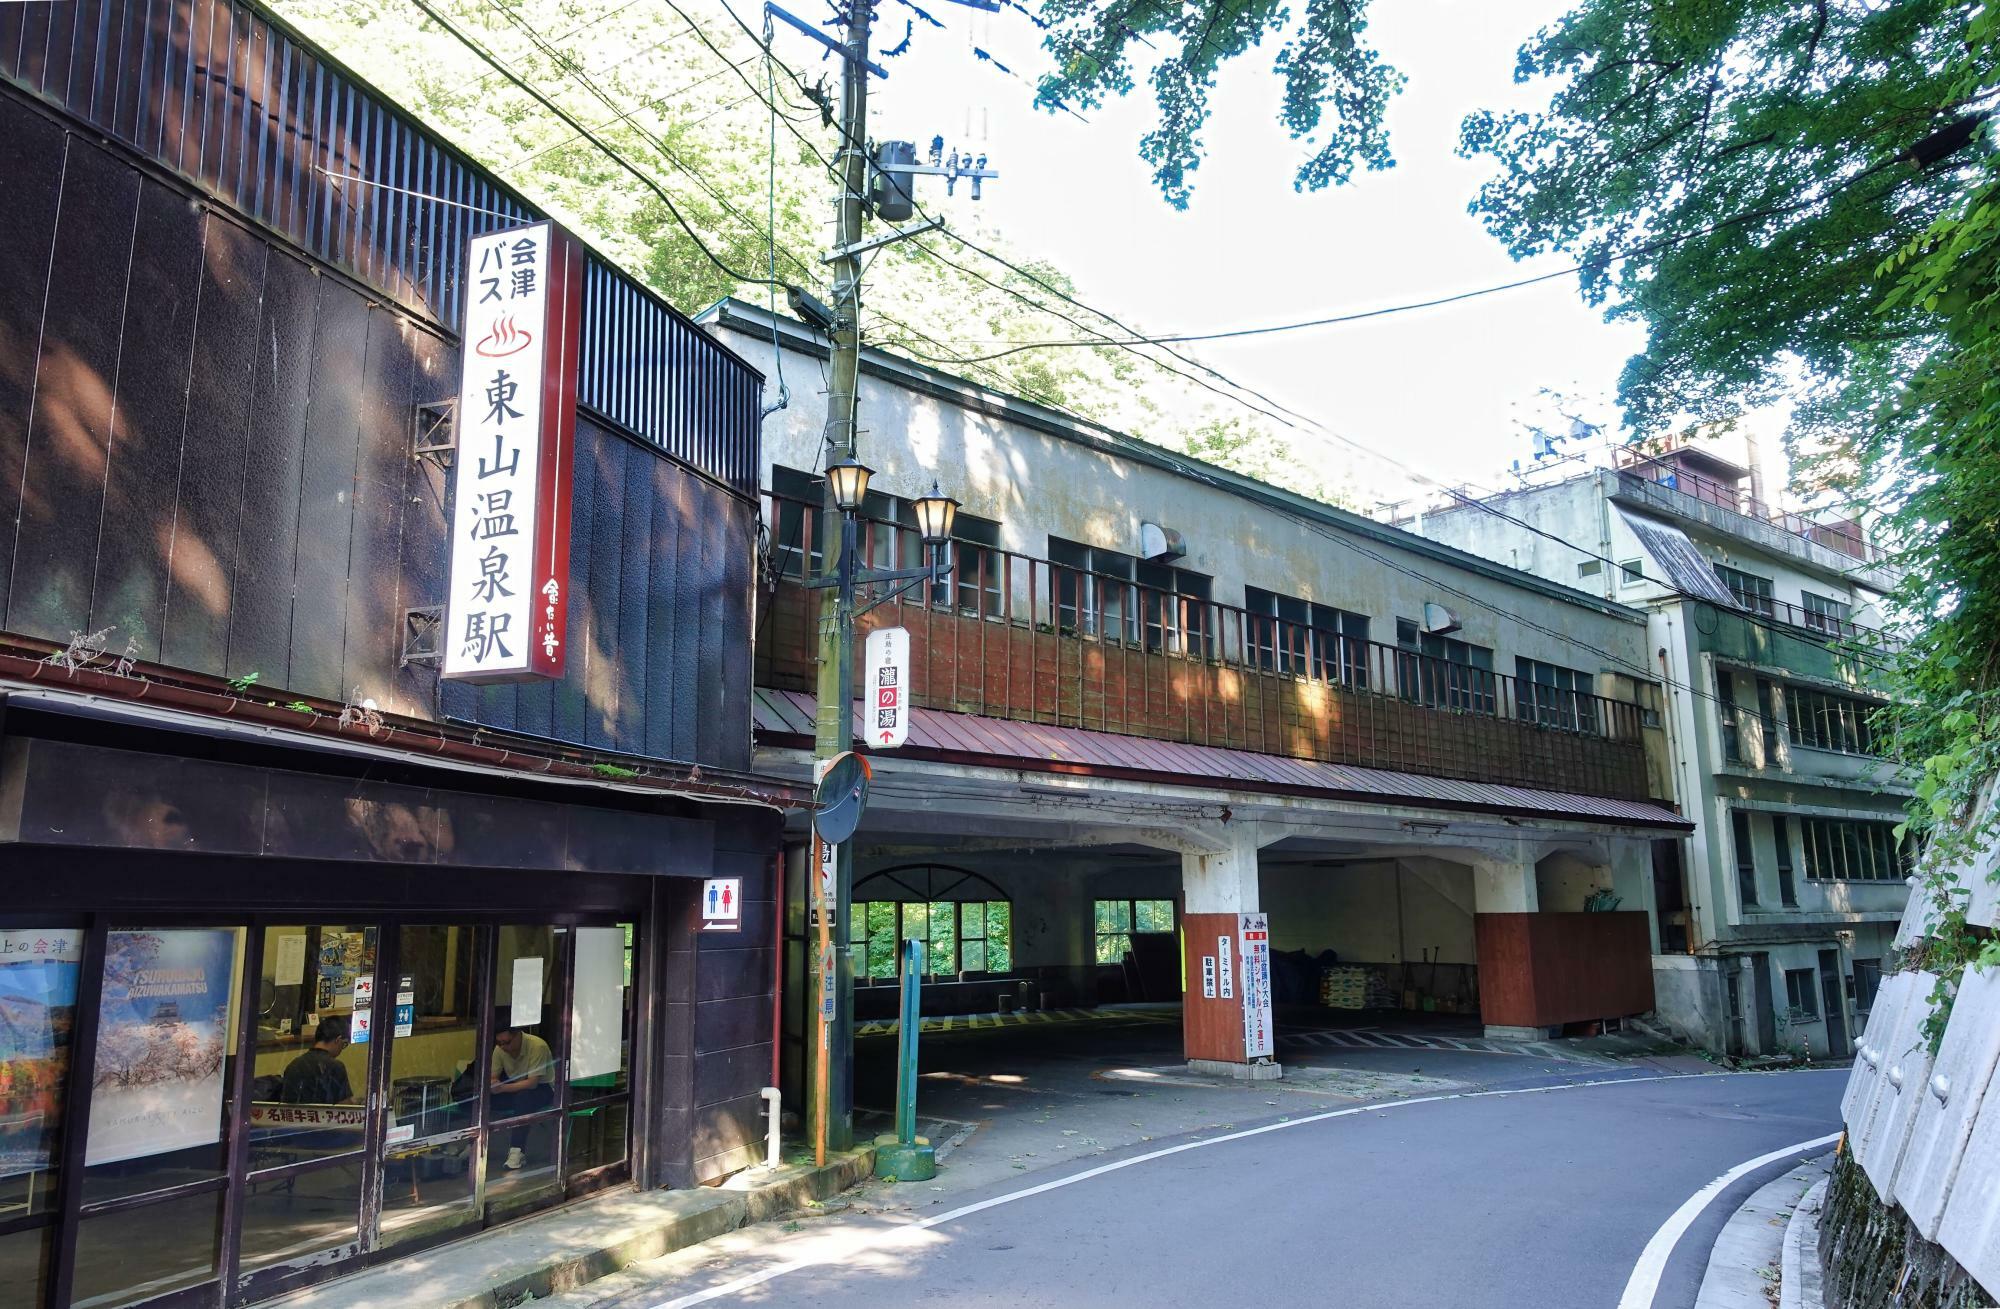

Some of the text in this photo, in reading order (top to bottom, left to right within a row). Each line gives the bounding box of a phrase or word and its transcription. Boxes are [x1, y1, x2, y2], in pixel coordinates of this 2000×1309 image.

[479, 241, 507, 304] バス
[510, 237, 537, 299] 会津
[460, 369, 525, 665] 東山温泉駅
[879, 667, 897, 728] 瀧の湯
[825, 975, 834, 1014] 注意
[1205, 957, 1214, 997] 駐車禁止
[1221, 937, 1231, 997] ターミナル内
